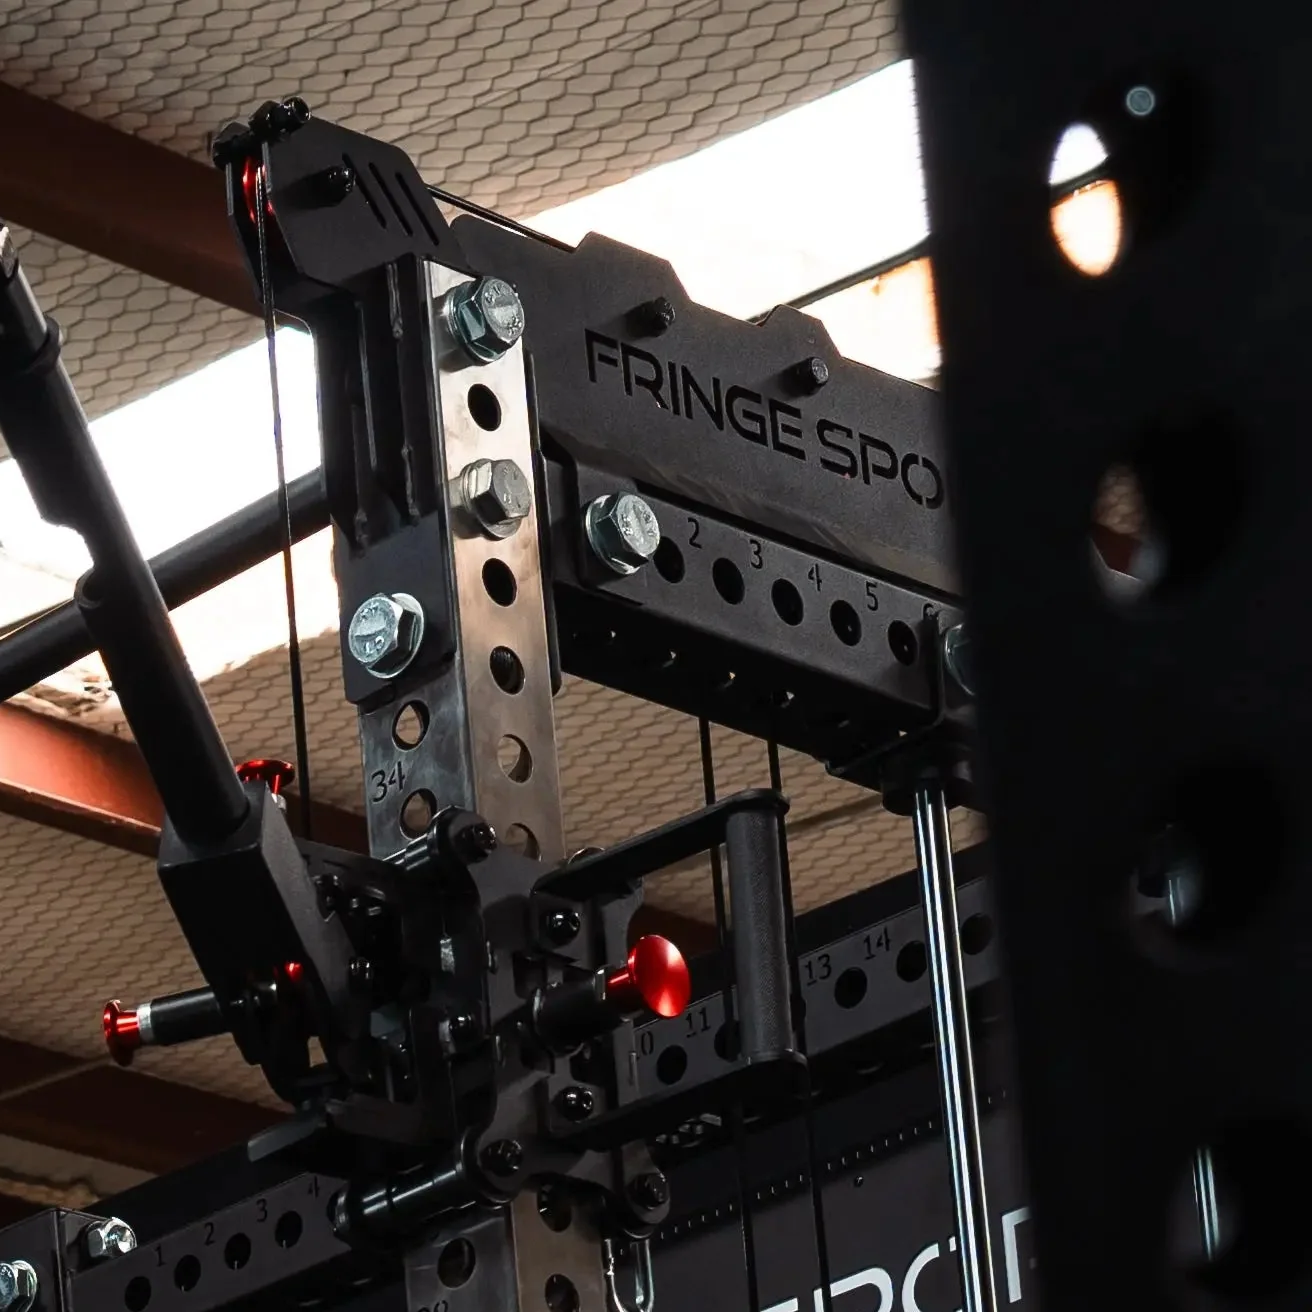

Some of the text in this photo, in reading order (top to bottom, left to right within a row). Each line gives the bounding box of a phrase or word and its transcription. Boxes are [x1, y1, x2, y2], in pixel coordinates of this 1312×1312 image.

[584, 328, 946, 510] FRINGE SPO
[687, 517, 703, 549] 2
[749, 539, 764, 570] 3
[807, 562, 824, 592] 4
[865, 581, 879, 612] 5
[371, 762, 407, 804] 34
[685, 926, 893, 1038] 11 13 14
[155, 1244, 165, 1268] 1
[204, 1222, 217, 1247] 2
[256, 1198, 269, 1223] 3
